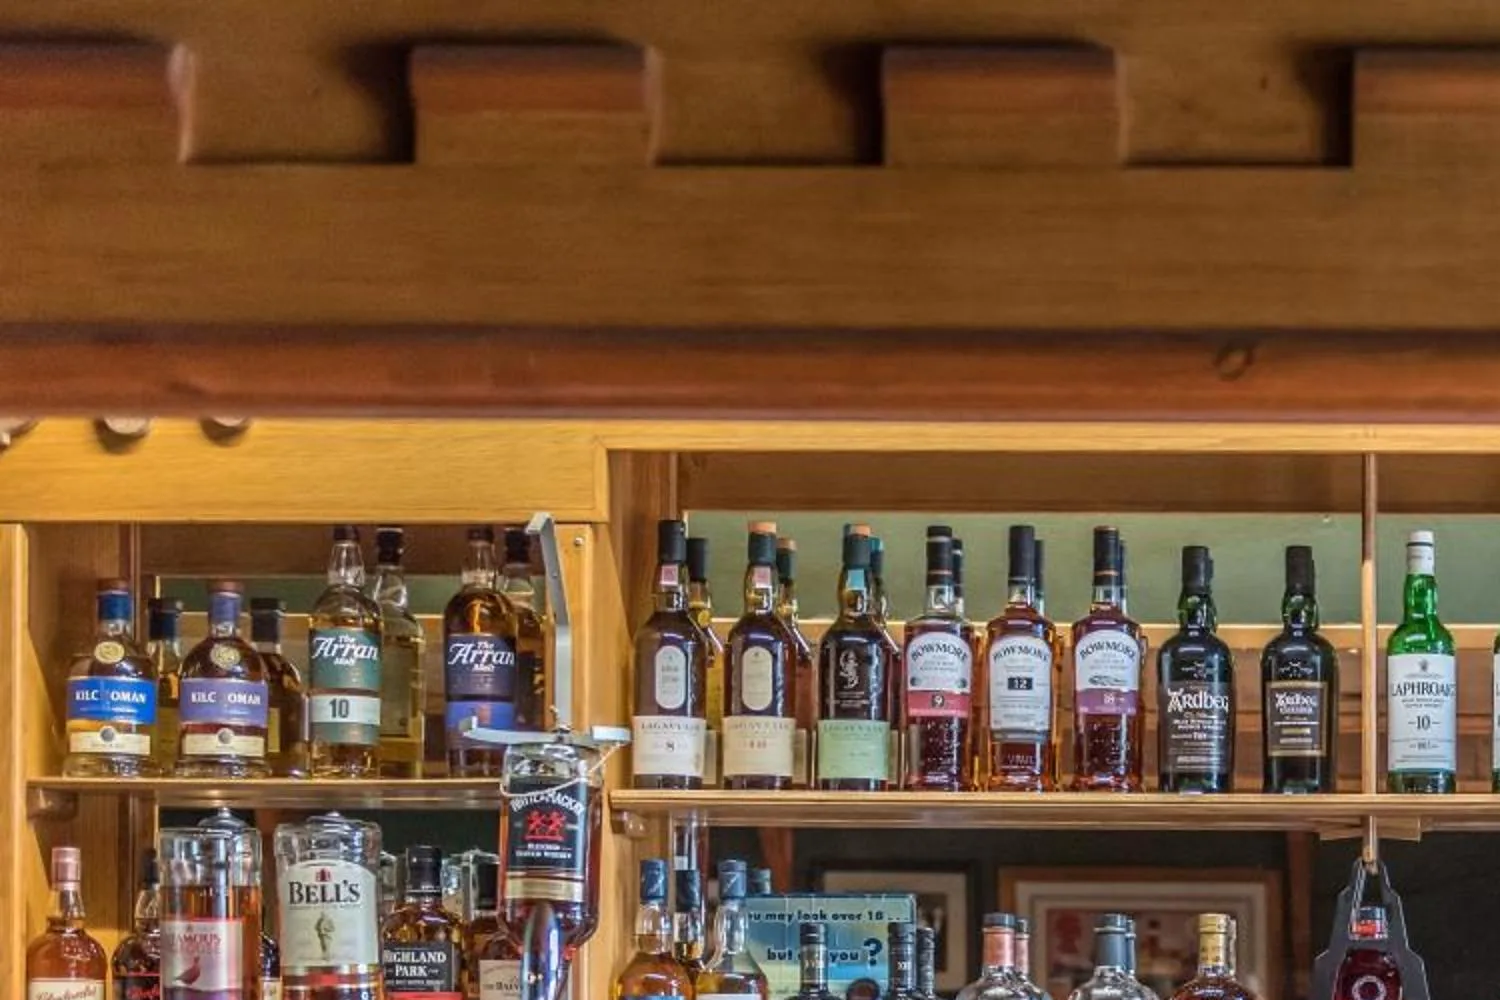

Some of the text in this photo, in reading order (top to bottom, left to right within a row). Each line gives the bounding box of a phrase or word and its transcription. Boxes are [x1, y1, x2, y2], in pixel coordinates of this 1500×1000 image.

[311, 635, 379, 661] Arran
[447, 640, 515, 666] Arran
[911, 643, 968, 662] BOWMORE
[992, 644, 1049, 663] BOWMORE
[1080, 640, 1136, 662] BOWMORE
[1013, 678, 1028, 689] 12
[1391, 682, 1457, 697] LAPHROAIG
[329, 697, 349, 719] 10
[1167, 687, 1230, 713] Ardbeg
[1416, 715, 1431, 731] 10
[289, 880, 361, 905] BELL'S
[764, 911, 794, 924] may
[797, 909, 827, 921] look
[831, 912, 863, 921] over
[867, 910, 884, 921] 18
[767, 938, 883, 967] but you ?
[395, 965, 430, 977] PARK
